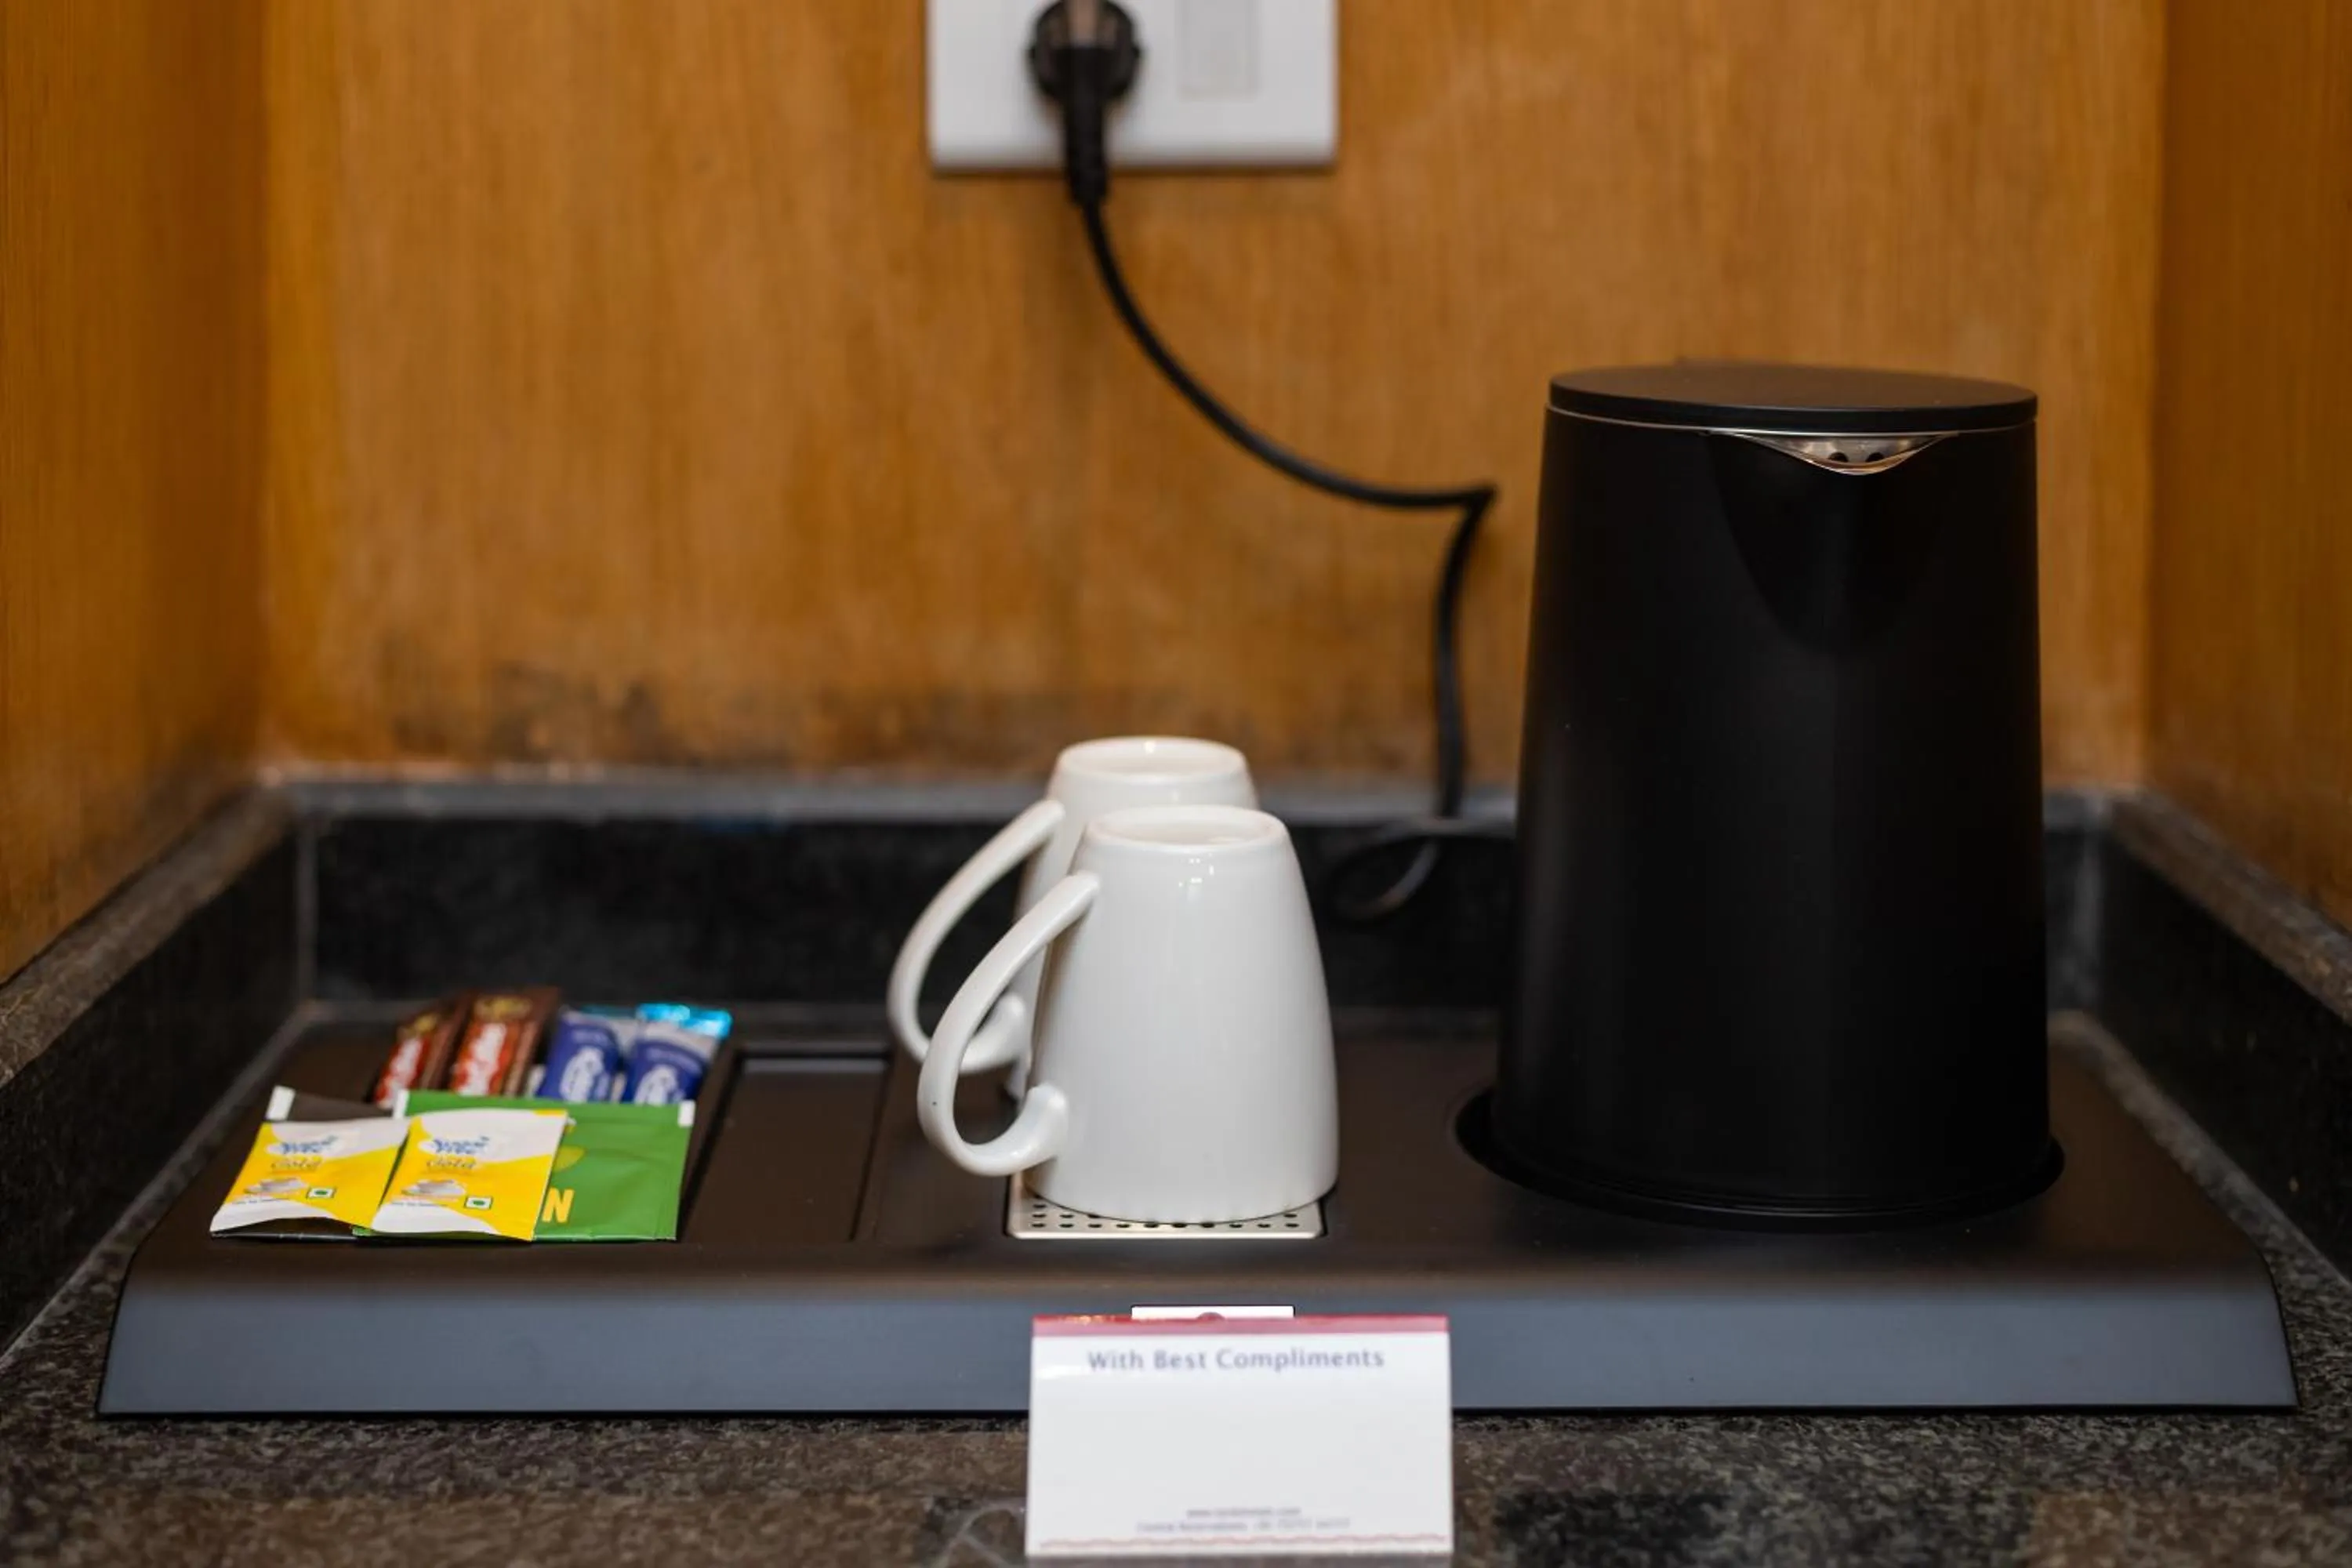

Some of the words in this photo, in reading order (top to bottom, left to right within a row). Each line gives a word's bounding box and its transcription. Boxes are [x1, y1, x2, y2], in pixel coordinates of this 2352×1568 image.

[1087, 1348, 1145, 1371] With
[1152, 1348, 1208, 1370] Best
[1215, 1346, 1386, 1373] Compliments
